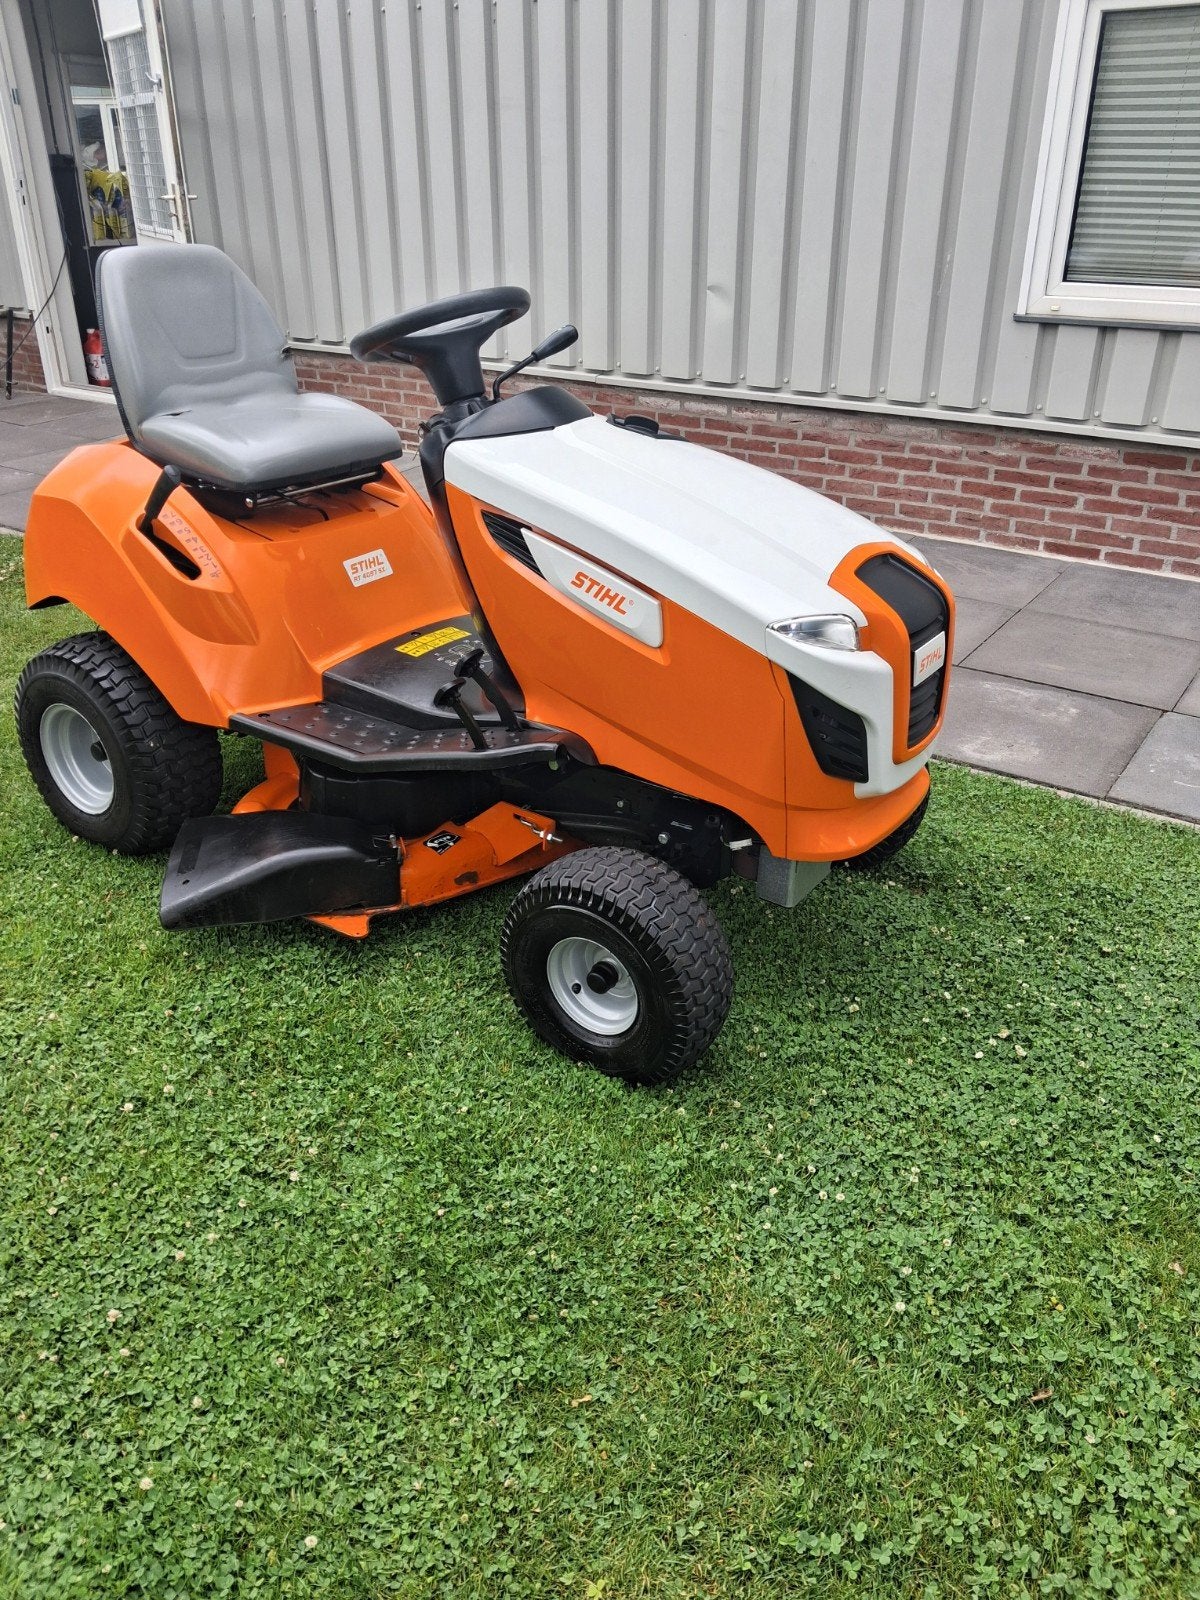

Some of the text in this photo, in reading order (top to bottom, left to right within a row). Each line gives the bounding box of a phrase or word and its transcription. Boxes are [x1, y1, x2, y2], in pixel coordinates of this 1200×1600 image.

[350, 555, 384, 575] STIHL
[570, 571, 627, 616] STIHL
[919, 646, 943, 674] STIHL
